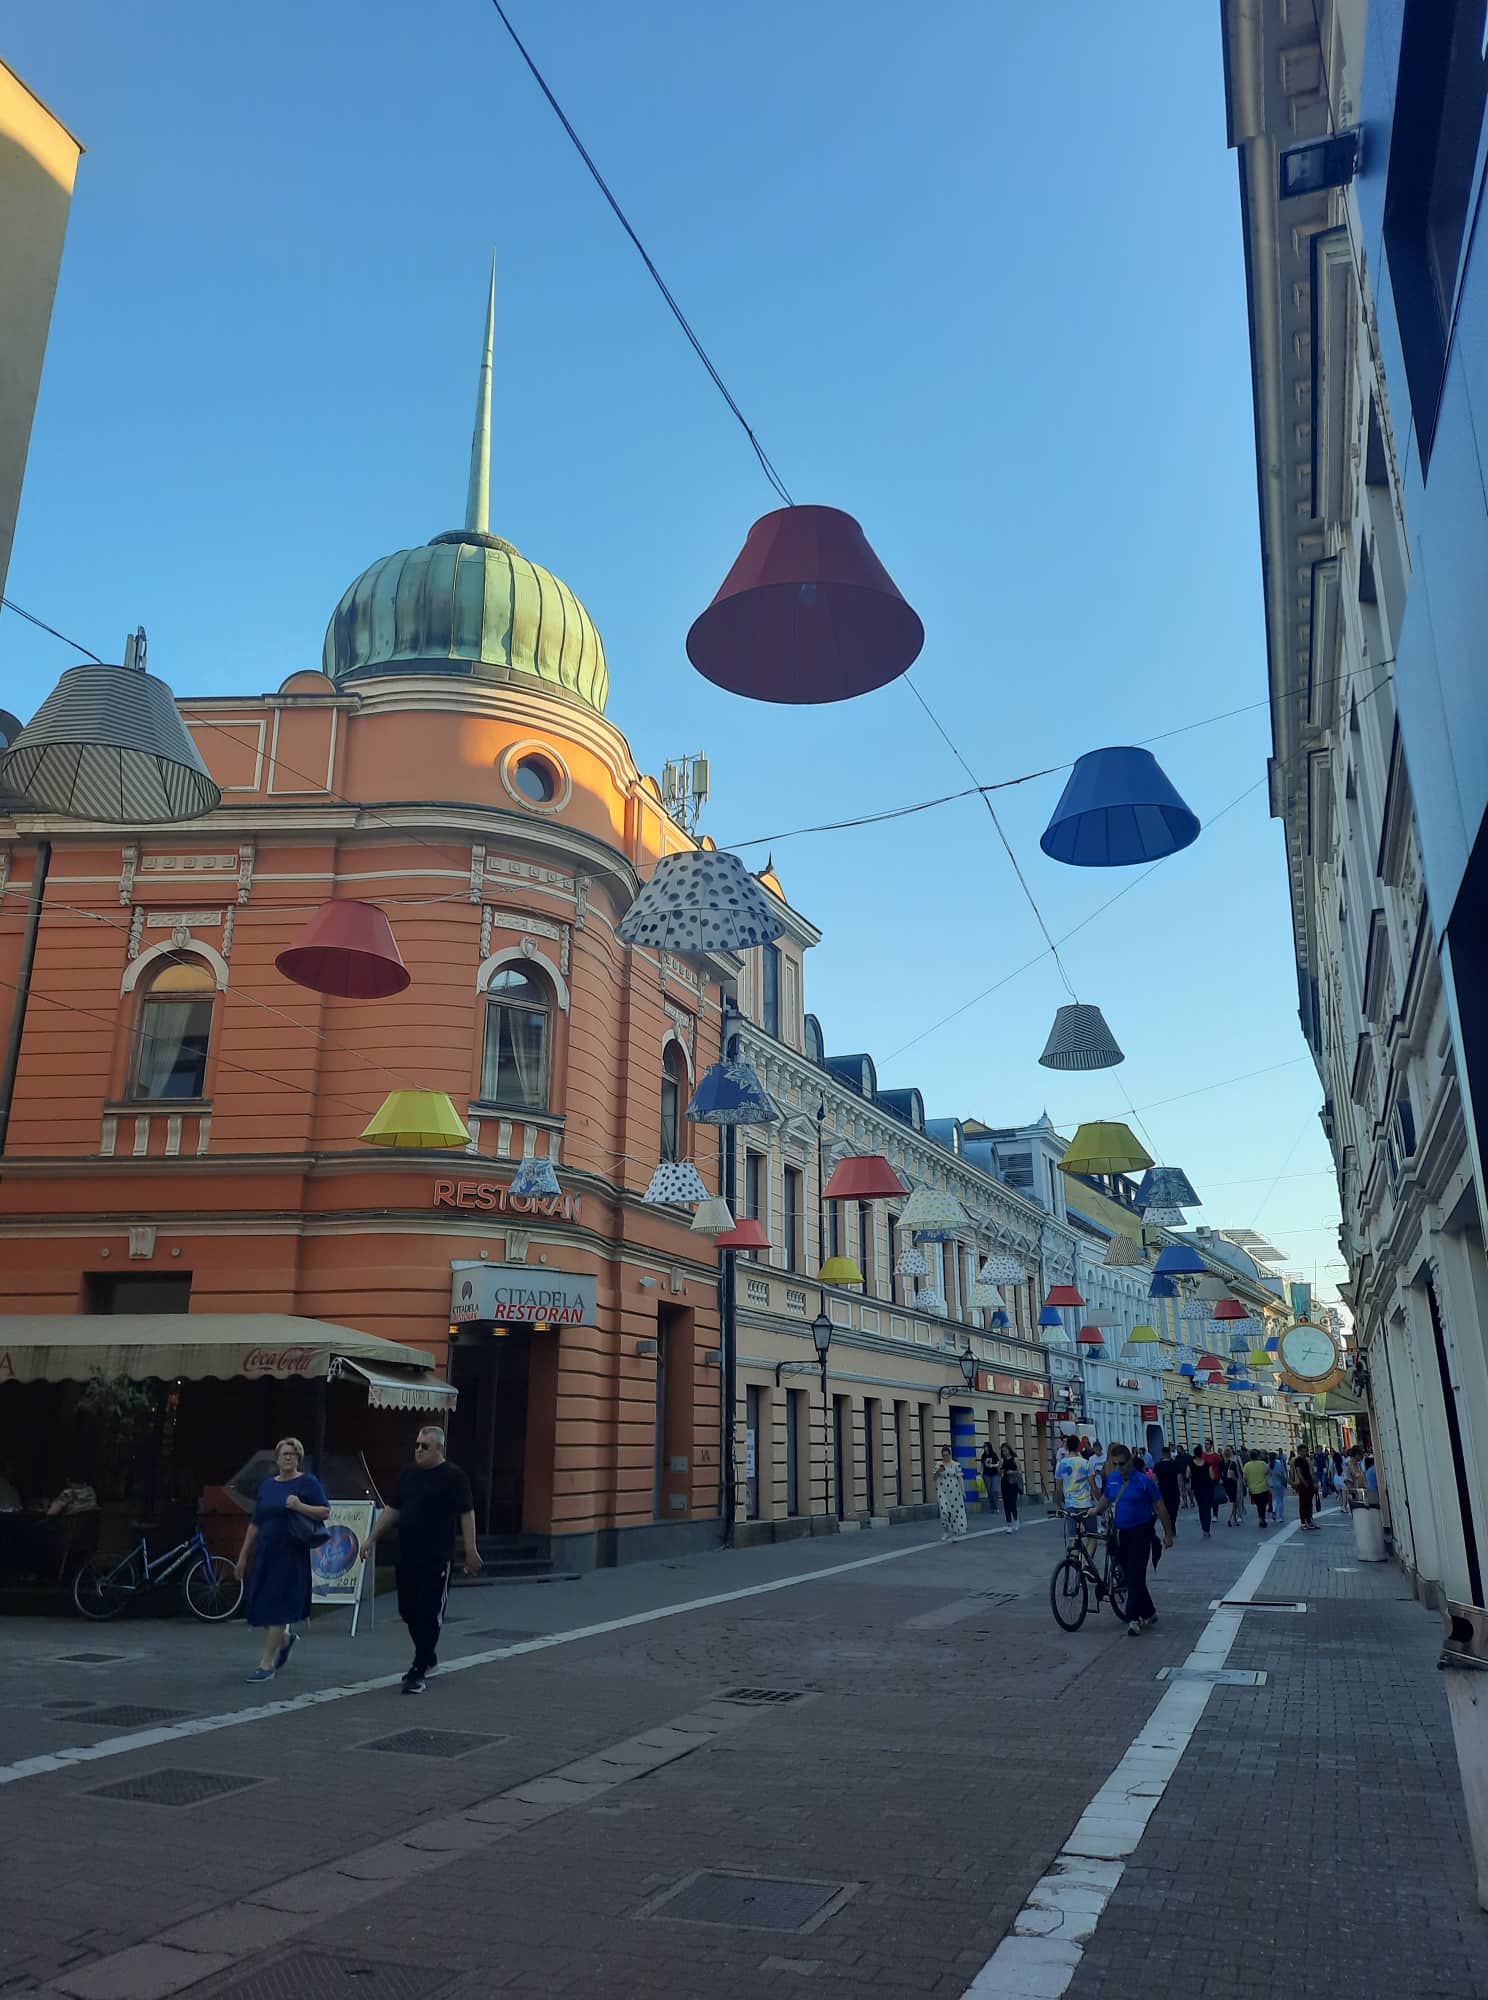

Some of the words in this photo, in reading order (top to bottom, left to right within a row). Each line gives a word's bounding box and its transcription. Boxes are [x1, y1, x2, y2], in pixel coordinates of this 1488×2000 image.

[433, 1179, 582, 1223] RESTORAN
[495, 1287, 585, 1309] CITADELA
[494, 1303, 583, 1324] RESTORAN
